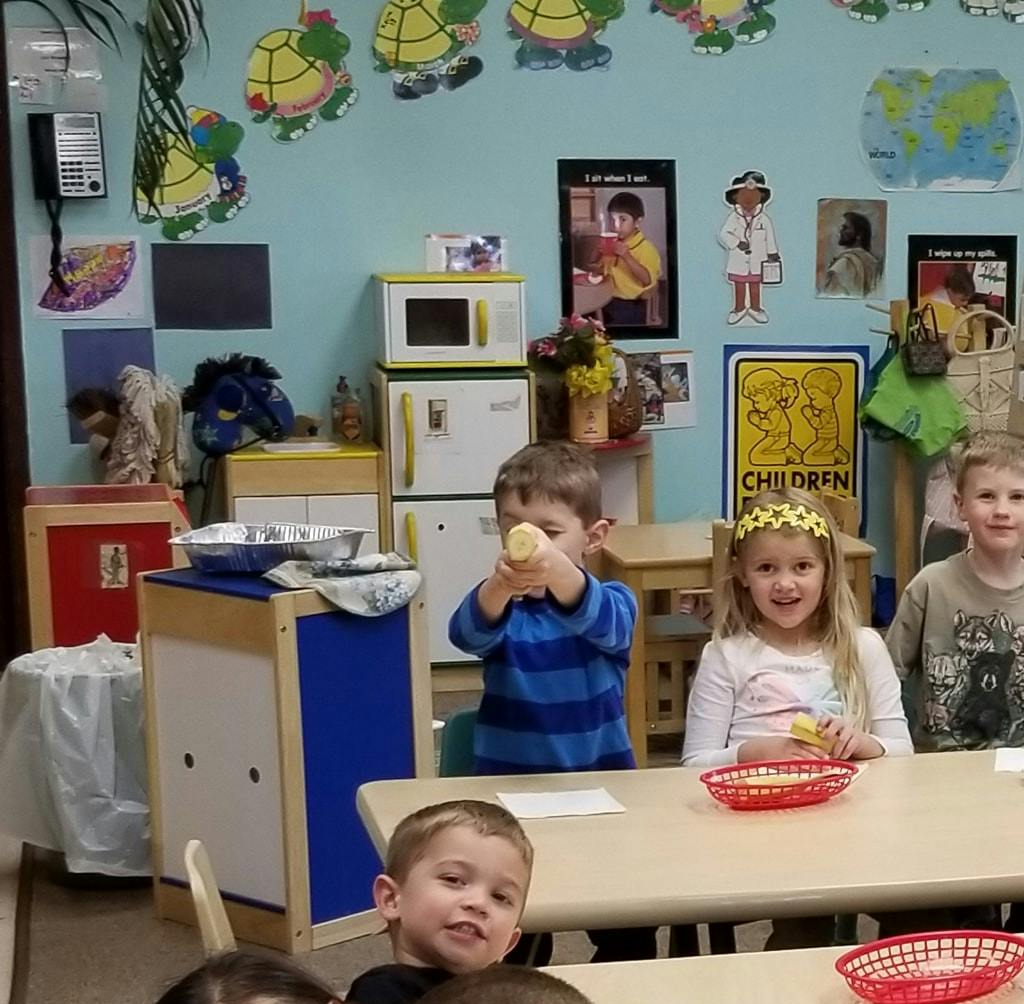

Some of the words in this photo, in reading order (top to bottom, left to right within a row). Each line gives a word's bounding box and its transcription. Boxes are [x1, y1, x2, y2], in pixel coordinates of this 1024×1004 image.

[868, 151, 896, 159] WORLD
[591, 174, 602, 182] sit
[603, 174, 626, 182] when
[175, 193, 213, 214] January
[934, 250, 952, 258] wipe
[953, 251, 964, 259] up
[977, 250, 998, 259] spills.
[742, 470, 849, 491] CHILDREN
